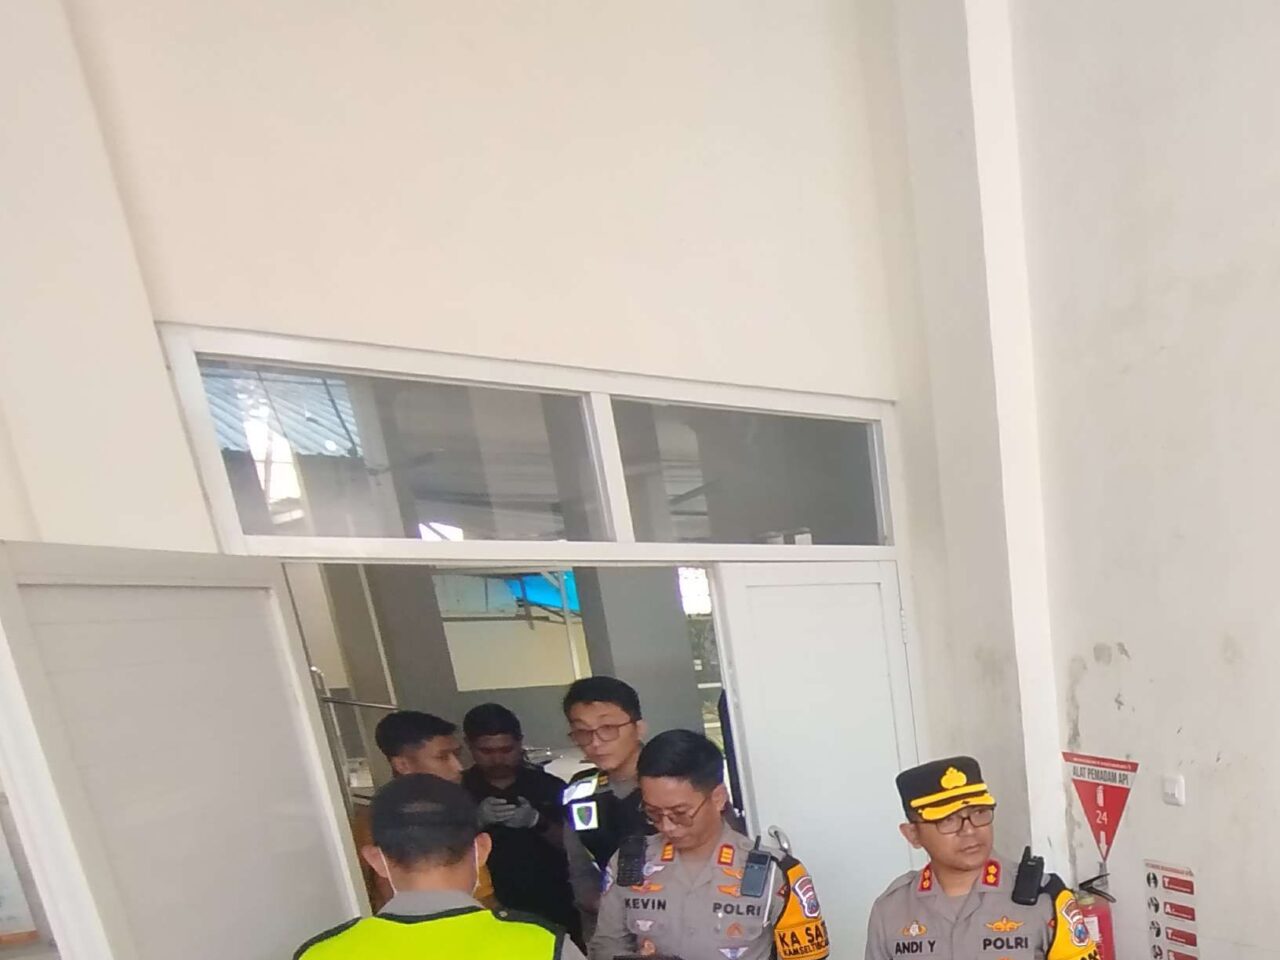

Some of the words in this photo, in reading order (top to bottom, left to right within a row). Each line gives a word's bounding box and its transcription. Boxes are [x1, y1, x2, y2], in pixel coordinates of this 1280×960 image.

[1072, 765, 1086, 778] ALAT
[1087, 768, 1118, 784] PEMADAM
[1118, 772, 1129, 786] API
[1096, 810, 1108, 825] 24
[624, 897, 667, 911] KEVIN
[712, 902, 762, 917] POLRI
[778, 931, 801, 949] KA
[895, 941, 923, 954] ANDI
[928, 940, 937, 952] Y
[982, 937, 1029, 951] POLRI
